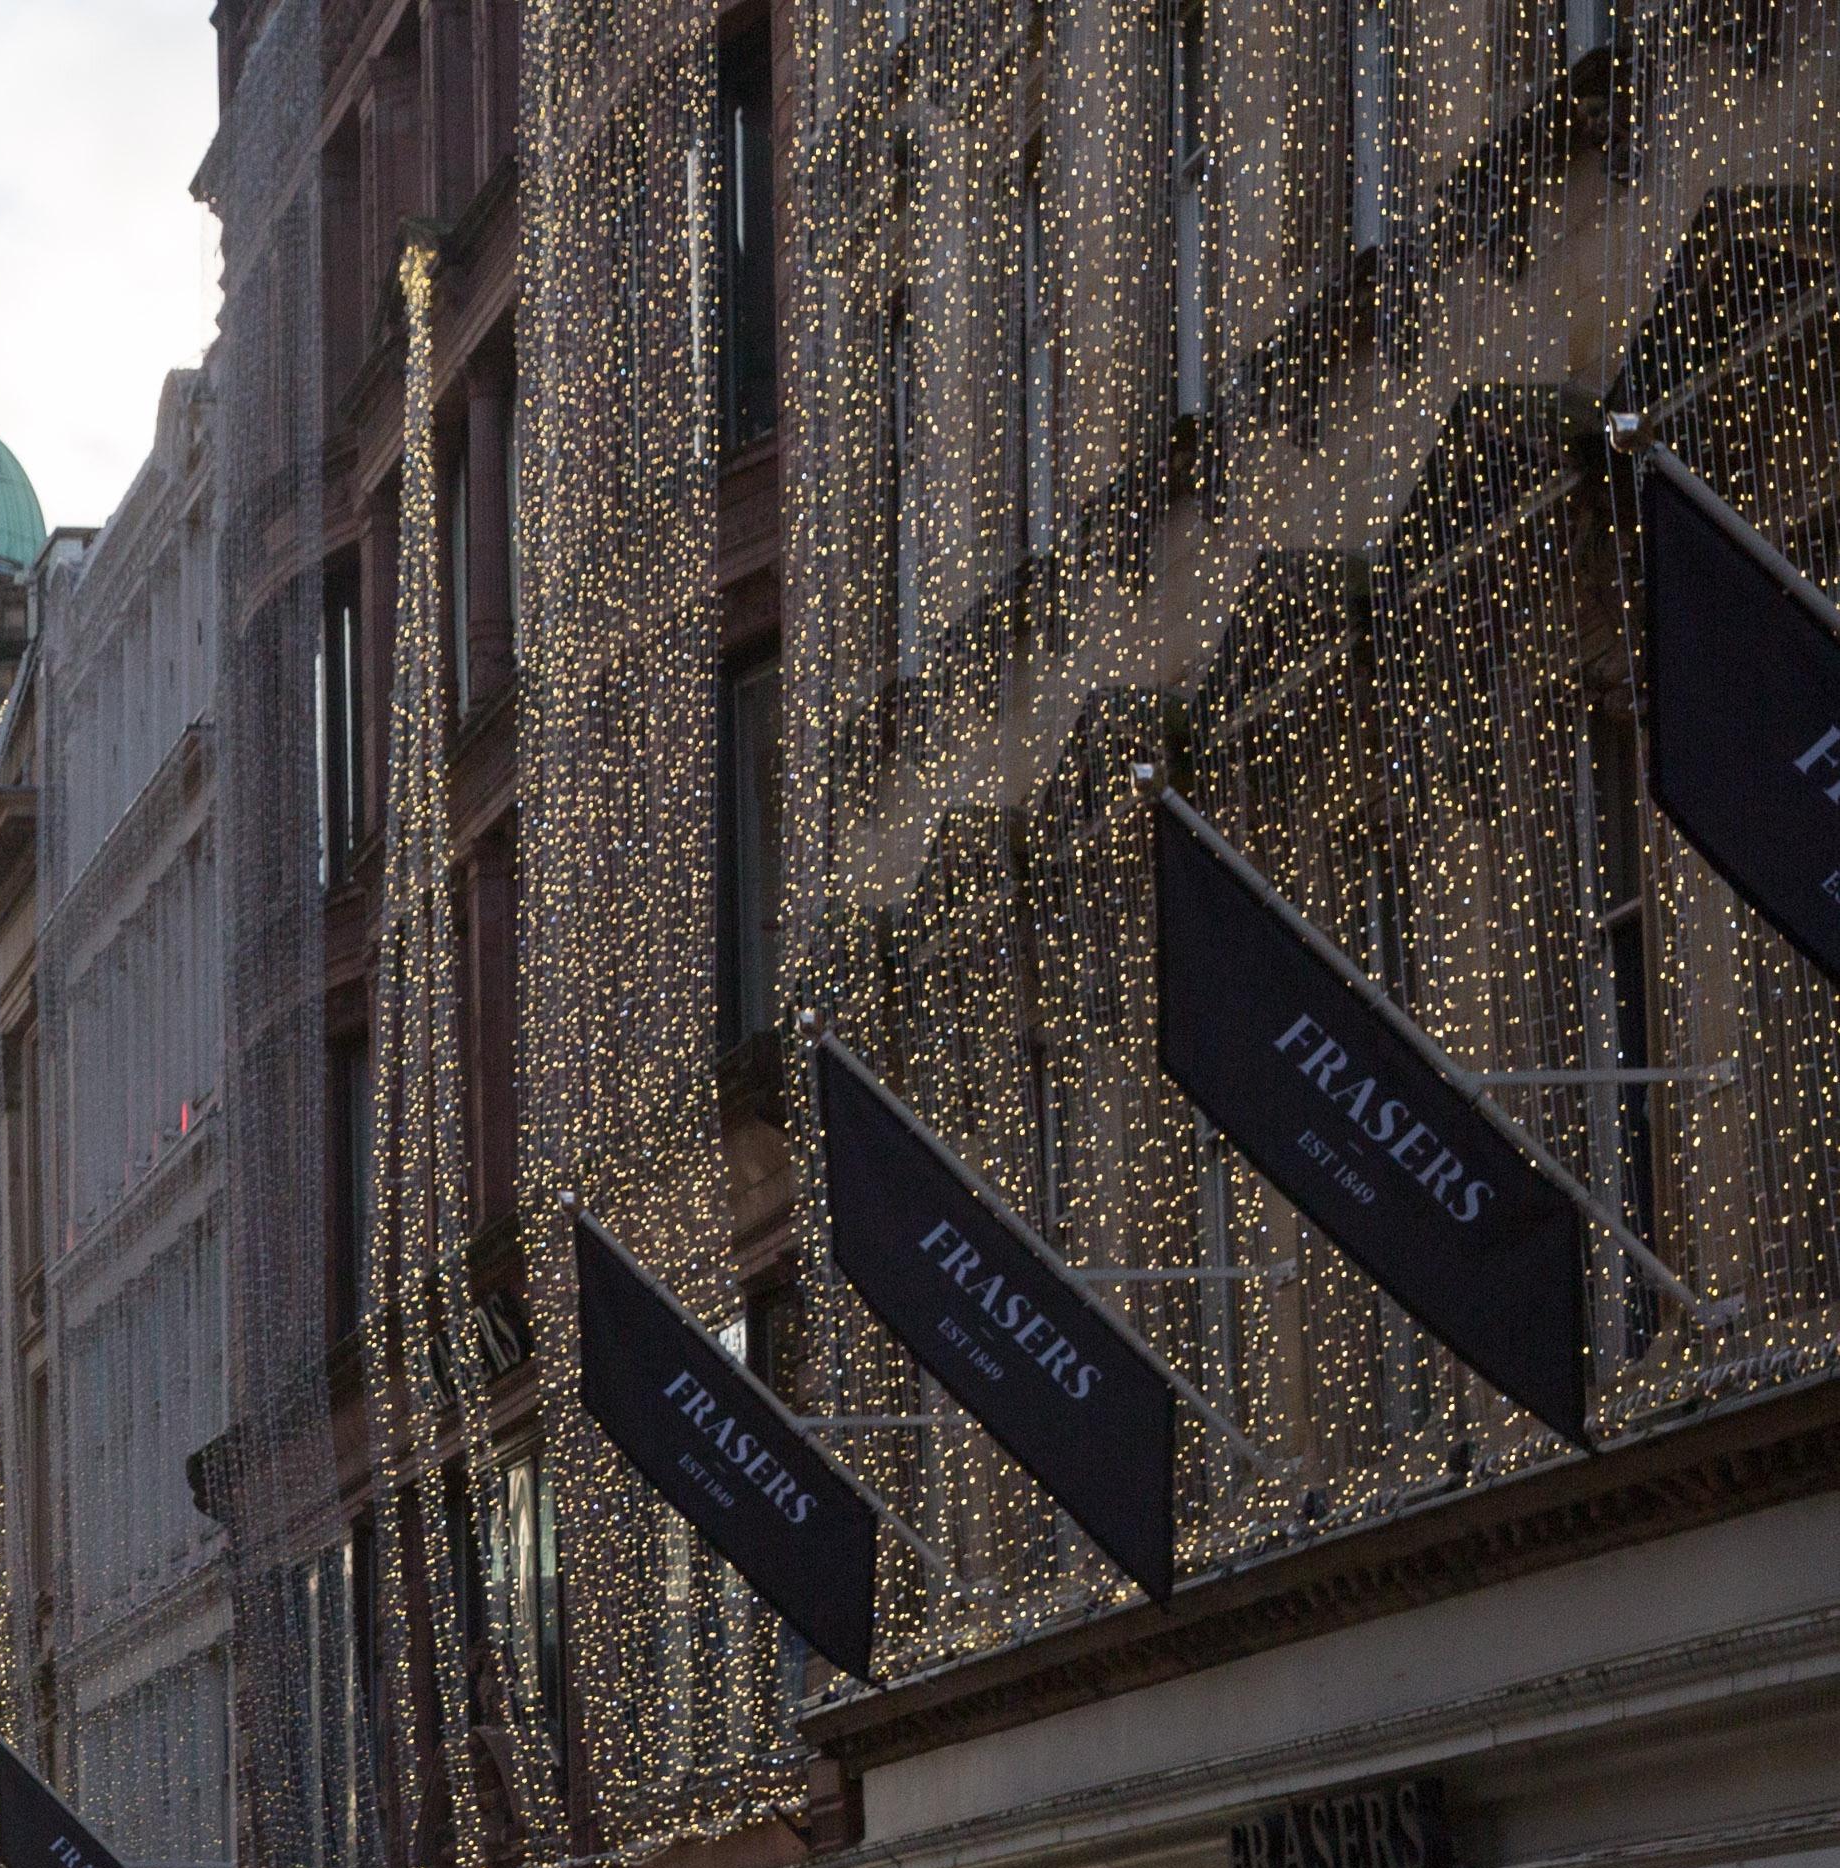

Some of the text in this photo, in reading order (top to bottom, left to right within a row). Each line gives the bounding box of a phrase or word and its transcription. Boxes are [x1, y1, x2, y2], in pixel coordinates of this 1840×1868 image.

[1273, 1013, 1496, 1226] FRASERS
[1297, 1128, 1376, 1205] EST 1849
[919, 1219, 1103, 1402] FRASERS
[936, 1314, 1005, 1383] EST 1849
[662, 1369, 818, 1525] FRASERS
[678, 1452, 709, 1482] EST
